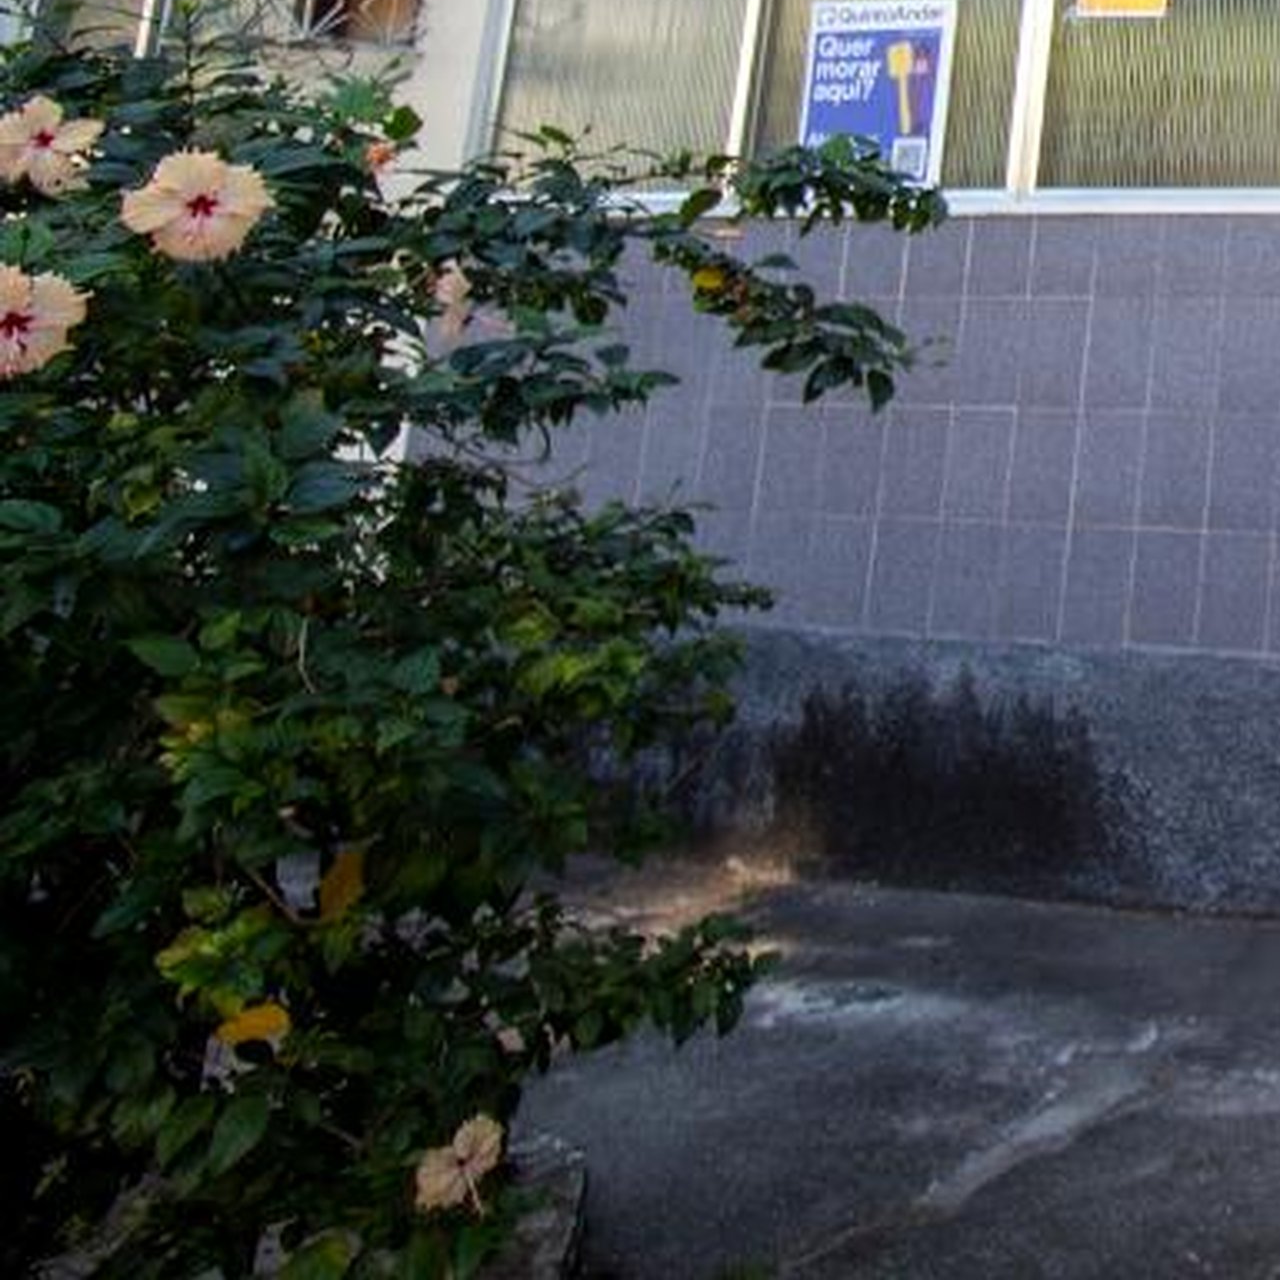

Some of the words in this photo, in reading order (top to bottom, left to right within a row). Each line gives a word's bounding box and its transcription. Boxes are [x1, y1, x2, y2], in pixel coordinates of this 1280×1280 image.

[819, 38, 874, 58] Quer
[816, 61, 882, 81] morar
[813, 79, 874, 106] aqui?
